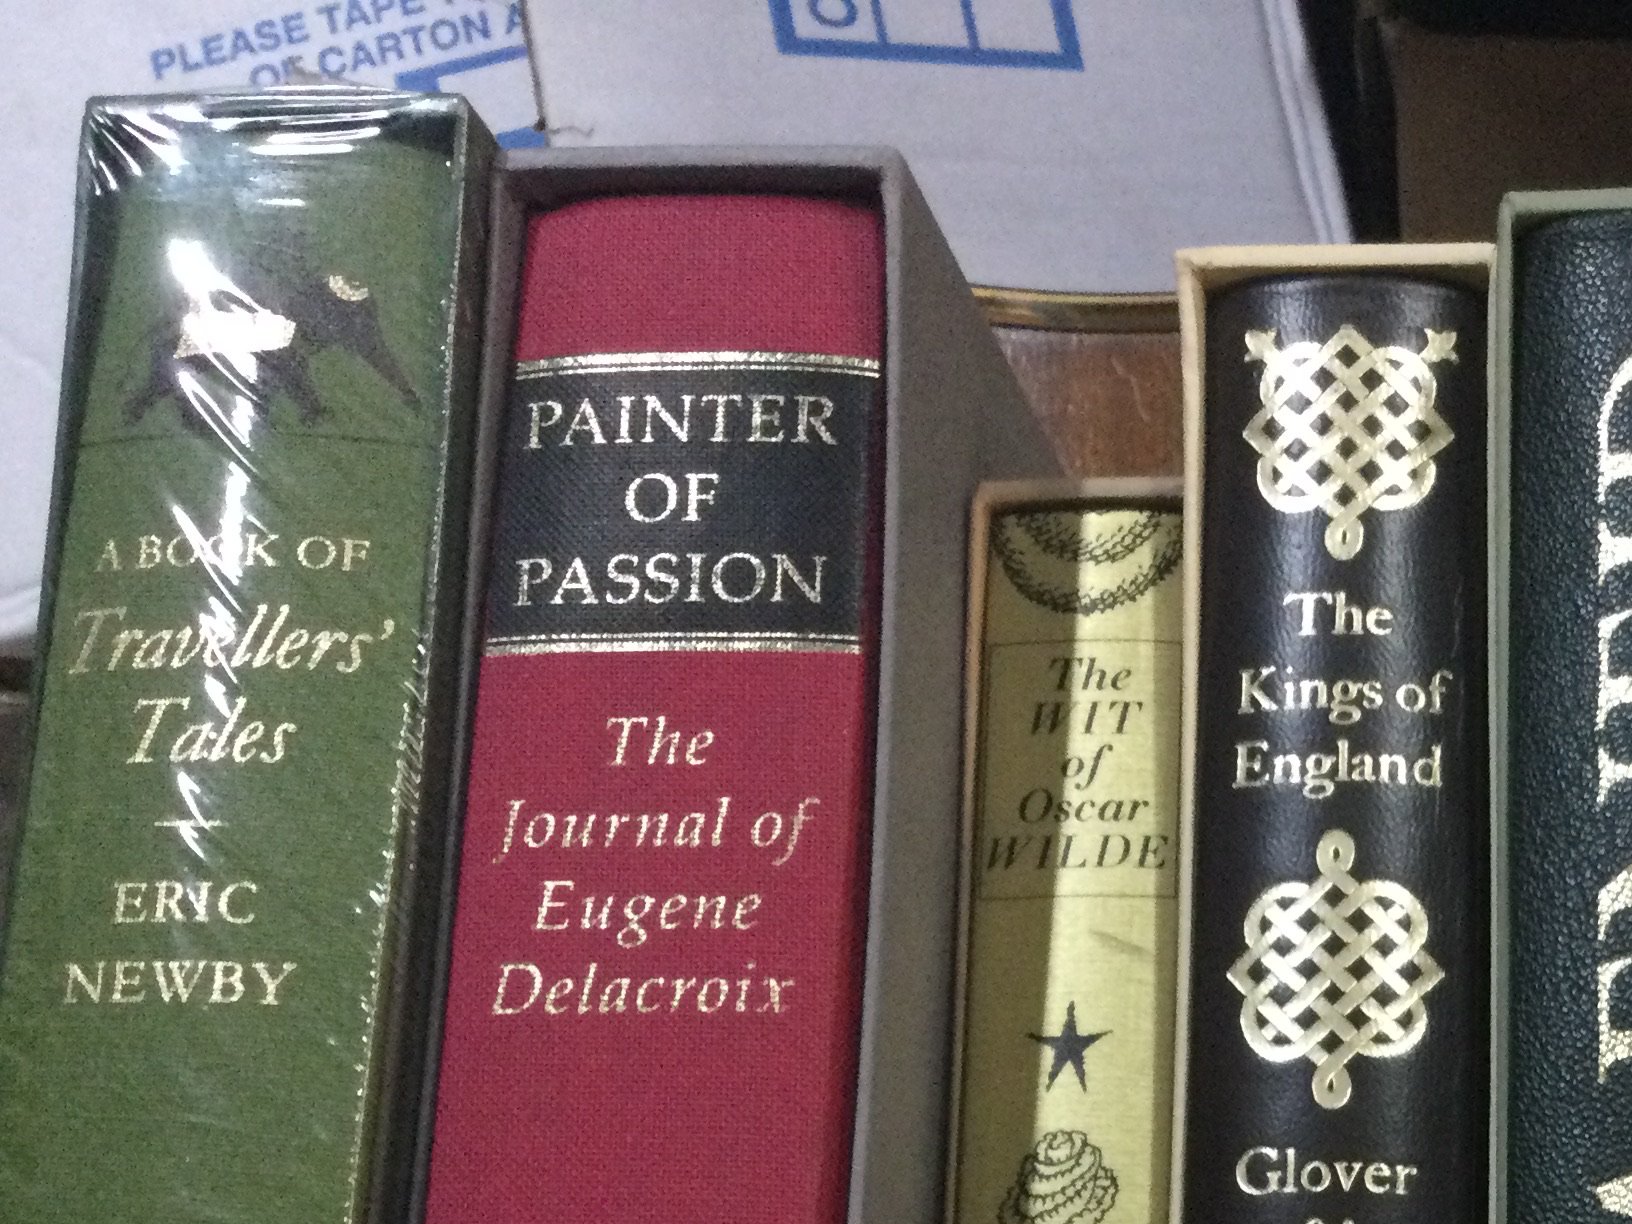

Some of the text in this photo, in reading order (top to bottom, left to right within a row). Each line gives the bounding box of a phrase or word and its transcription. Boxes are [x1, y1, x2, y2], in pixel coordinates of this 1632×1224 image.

[150, 12, 310, 80] PLEASE
[317, 10, 492, 79] CARTON
[524, 395, 837, 450] PAINTER
[625, 473, 720, 523] OF
[94, 537, 122, 572] A
[297, 535, 371, 571] OF
[513, 552, 828, 606] PASSION
[1283, 591, 1394, 637] The
[1047, 656, 1132, 692] The
[1237, 665, 1453, 725] Kings of
[126, 696, 297, 764] Tales
[609, 715, 715, 766] The
[1029, 700, 1144, 736] WIT
[1060, 743, 1114, 790] of
[1231, 738, 1443, 800] England
[1016, 787, 1150, 824] Oscar
[492, 796, 821, 866] Journal of
[985, 833, 1169, 871] WILDE
[111, 880, 259, 924] ERIC
[531, 880, 763, 949] Eugene
[63, 960, 298, 1005] NEWBY
[491, 961, 796, 1015] Delacroix
[1235, 1146, 1418, 1196] Glover
